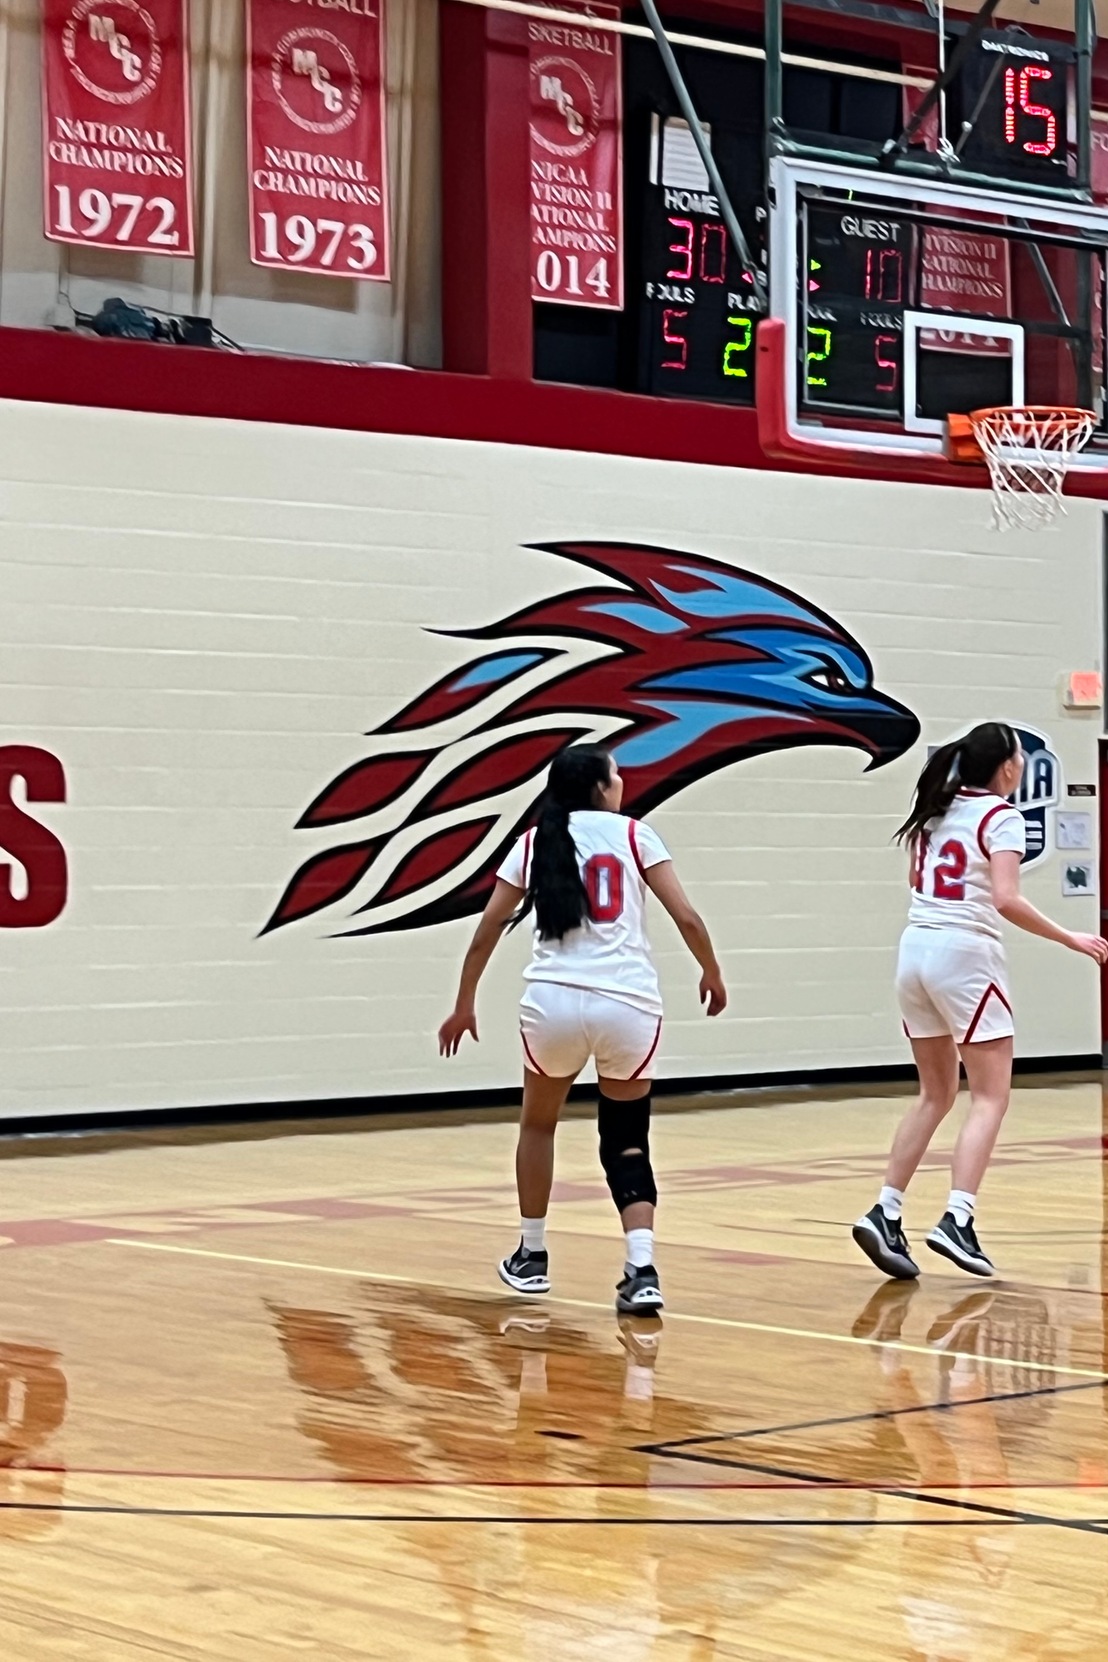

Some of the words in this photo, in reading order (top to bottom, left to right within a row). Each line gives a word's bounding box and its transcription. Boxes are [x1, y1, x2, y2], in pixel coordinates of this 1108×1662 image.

[528, 22, 614, 55] SKETBALL
[55, 116, 172, 153] NATIONAL
[1005, 67, 1055, 156] 15
[49, 141, 183, 178] CHAMPIONS
[264, 145, 368, 181] NATIONAL
[253, 169, 381, 206] CHAMPIONS
[531, 181, 592, 209] VISION
[664, 189, 721, 216] HOME
[54, 184, 179, 246] 1972
[531, 203, 609, 232] ATIONAL
[840, 215, 902, 242] GUEST
[258, 211, 378, 270] 1973
[532, 226, 617, 253] AMPIONS
[666, 217, 727, 284] 30
[531, 250, 611, 298] 014
[864, 249, 904, 302] 10
[922, 272, 1004, 299] HAMPIONS
[661, 309, 689, 370] 5
[723, 316, 751, 377] 2
[807, 326, 832, 386] 2
[875, 335, 898, 391] 5
[583, 853, 625, 925] 0
[915, 831, 968, 901] 12
